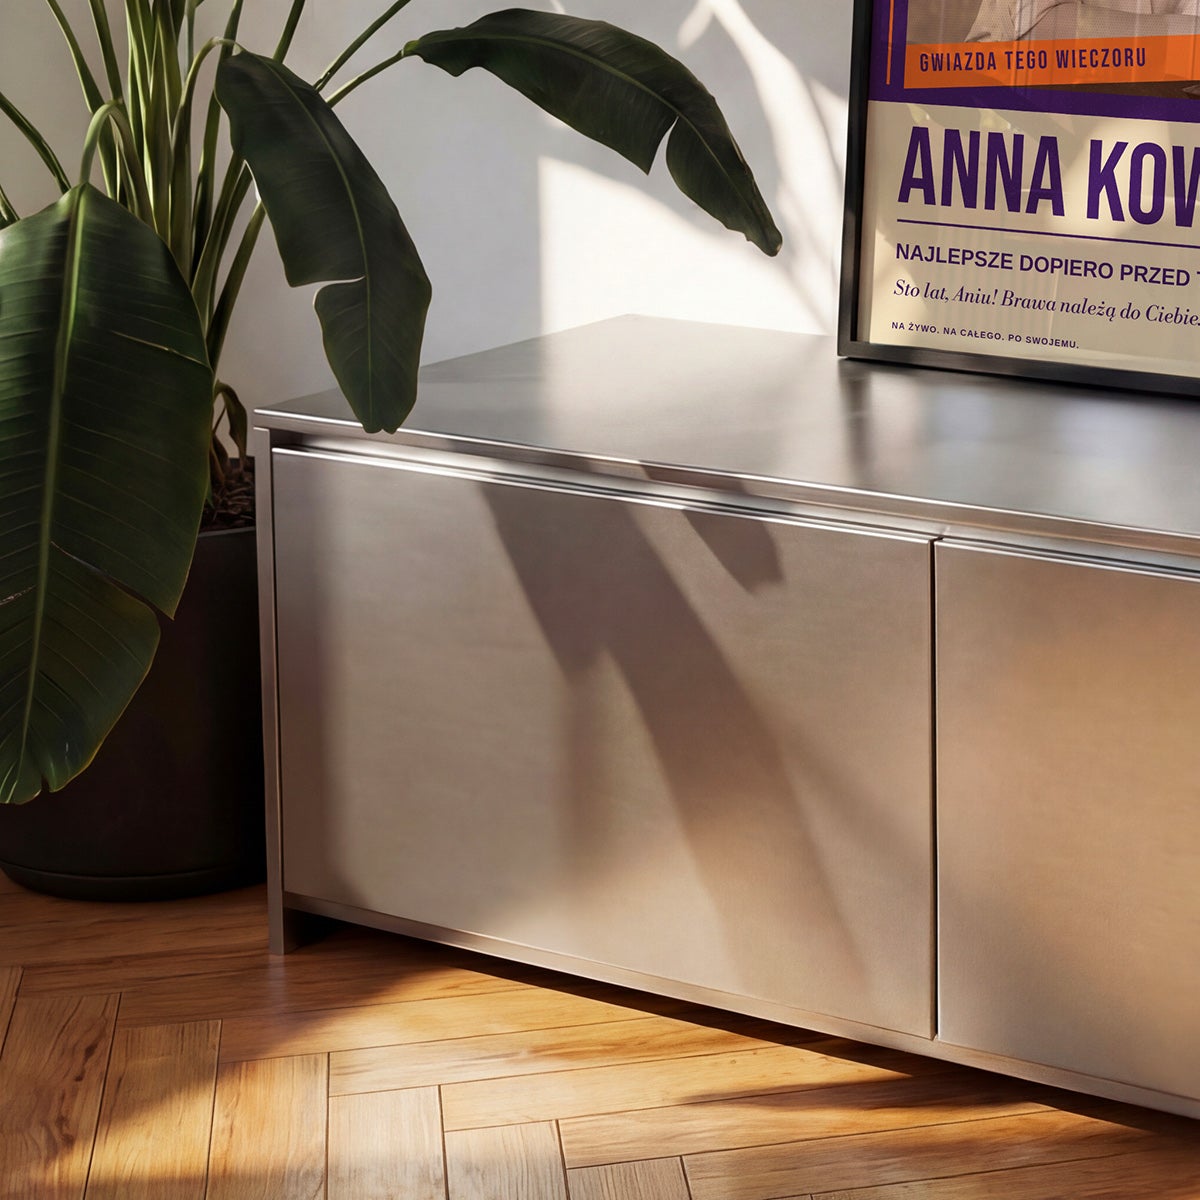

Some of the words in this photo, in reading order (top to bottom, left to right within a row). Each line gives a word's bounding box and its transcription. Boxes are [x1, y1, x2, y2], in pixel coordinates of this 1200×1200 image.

[920, 52, 996, 72] GWIAZDA
[1004, 50, 1047, 70] TEGO
[1056, 47, 1145, 69] WIECZORU
[898, 126, 1065, 216] ANNA
[896, 243, 1013, 270] NAJLEPSZE
[1020, 255, 1113, 279] DOPIERO
[1120, 264, 1190, 286] PRZED
[894, 280, 920, 297] Sto
[924, 282, 949, 301] lat,
[952, 286, 998, 305] Aniu!
[1001, 290, 1056, 311] Brawa
[1060, 298, 1116, 322] należą
[1120, 302, 1141, 320] do
[1146, 305, 1200, 326] Ciebie.
[892, 322, 905, 330] NA
[908, 322, 939, 334] ŻYWO.
[943, 327, 957, 335] NA
[960, 329, 1004, 341] CAŁEGO.
[1008, 334, 1022, 342] PO
[1025, 336, 1079, 349] SWOJEMU.
